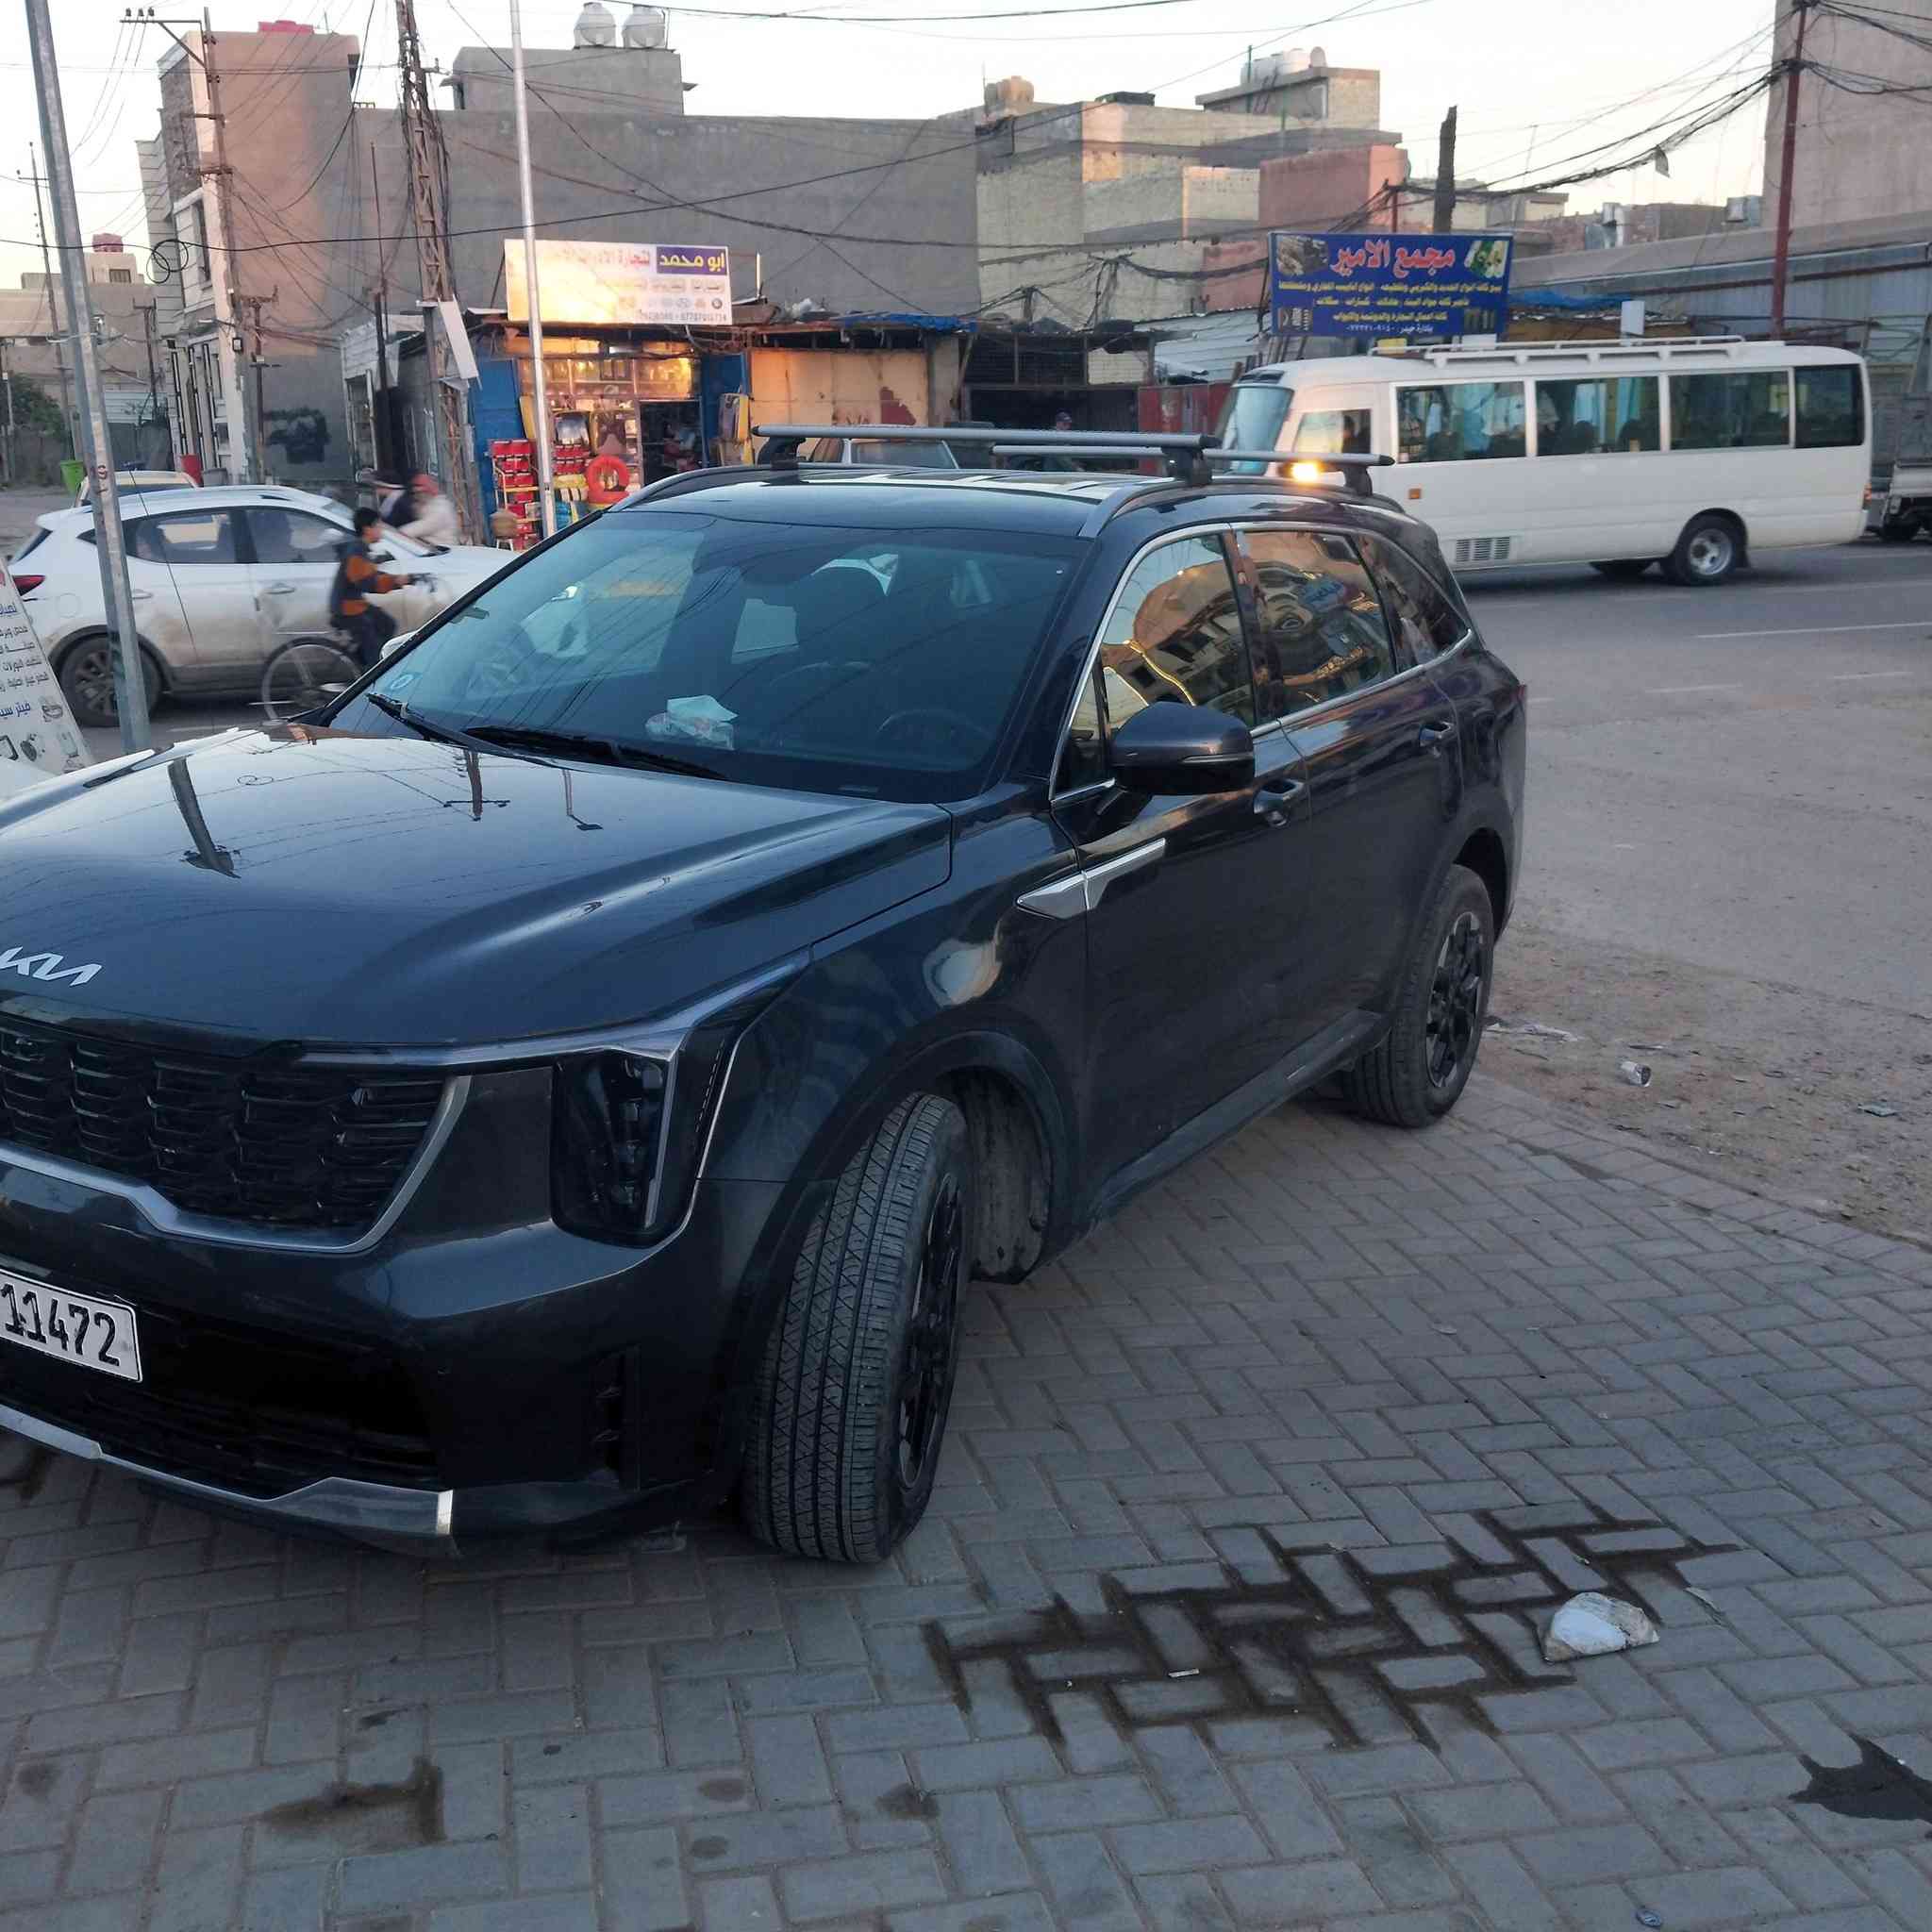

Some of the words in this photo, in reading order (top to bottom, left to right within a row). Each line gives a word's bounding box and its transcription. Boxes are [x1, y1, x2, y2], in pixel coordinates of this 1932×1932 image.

[659, 255, 704, 268] محمد
[708, 252, 725, 272] ابو
[1329, 239, 1391, 277] الامير
[1392, 246, 1456, 278] مجمع
[0, 1283, 120, 1367] 11472
